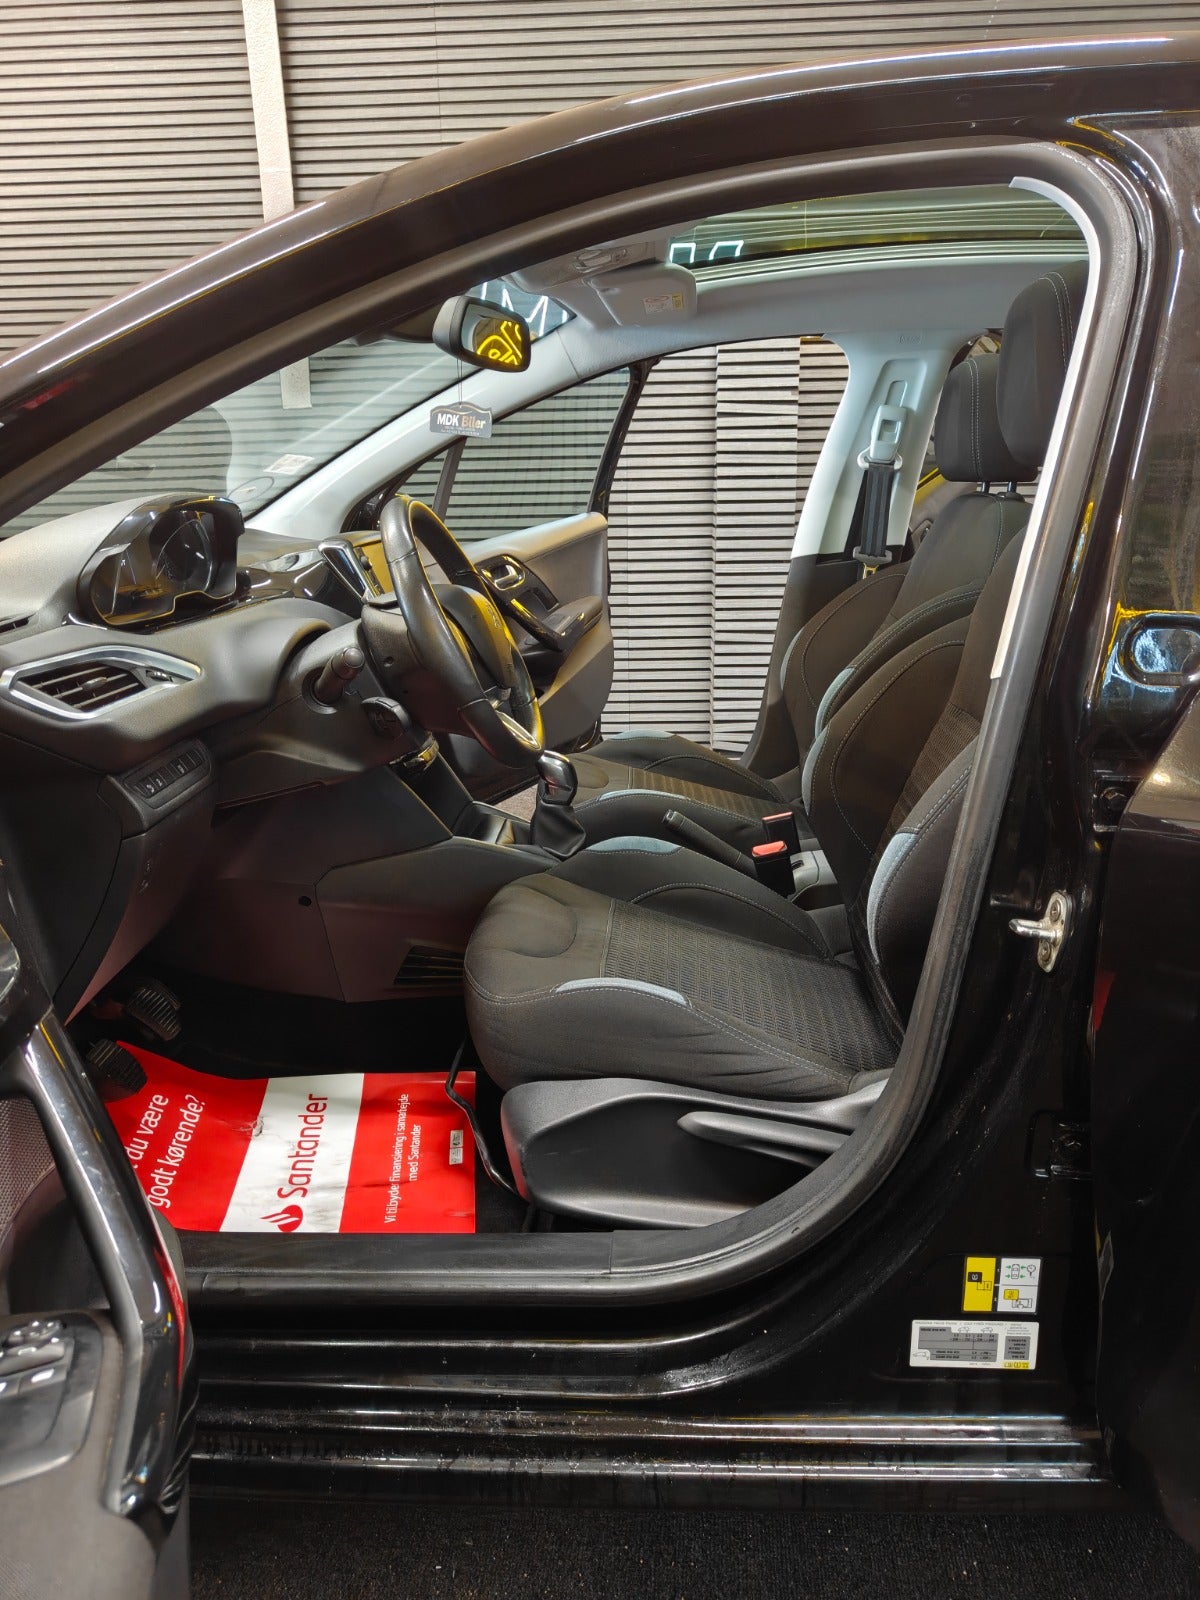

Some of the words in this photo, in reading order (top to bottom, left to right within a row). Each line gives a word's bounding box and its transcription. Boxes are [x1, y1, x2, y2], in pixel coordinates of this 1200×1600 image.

[437, 413, 460, 427] MDK
[136, 1094, 169, 1135] være
[157, 1094, 205, 1167] kørende?
[124, 1137, 149, 1160] du
[277, 1093, 328, 1199] Santander
[408, 1124, 421, 1160] Santander
[146, 1167, 177, 1209] godt
[408, 1162, 419, 1181] med
[384, 1215, 397, 1224] Vi
